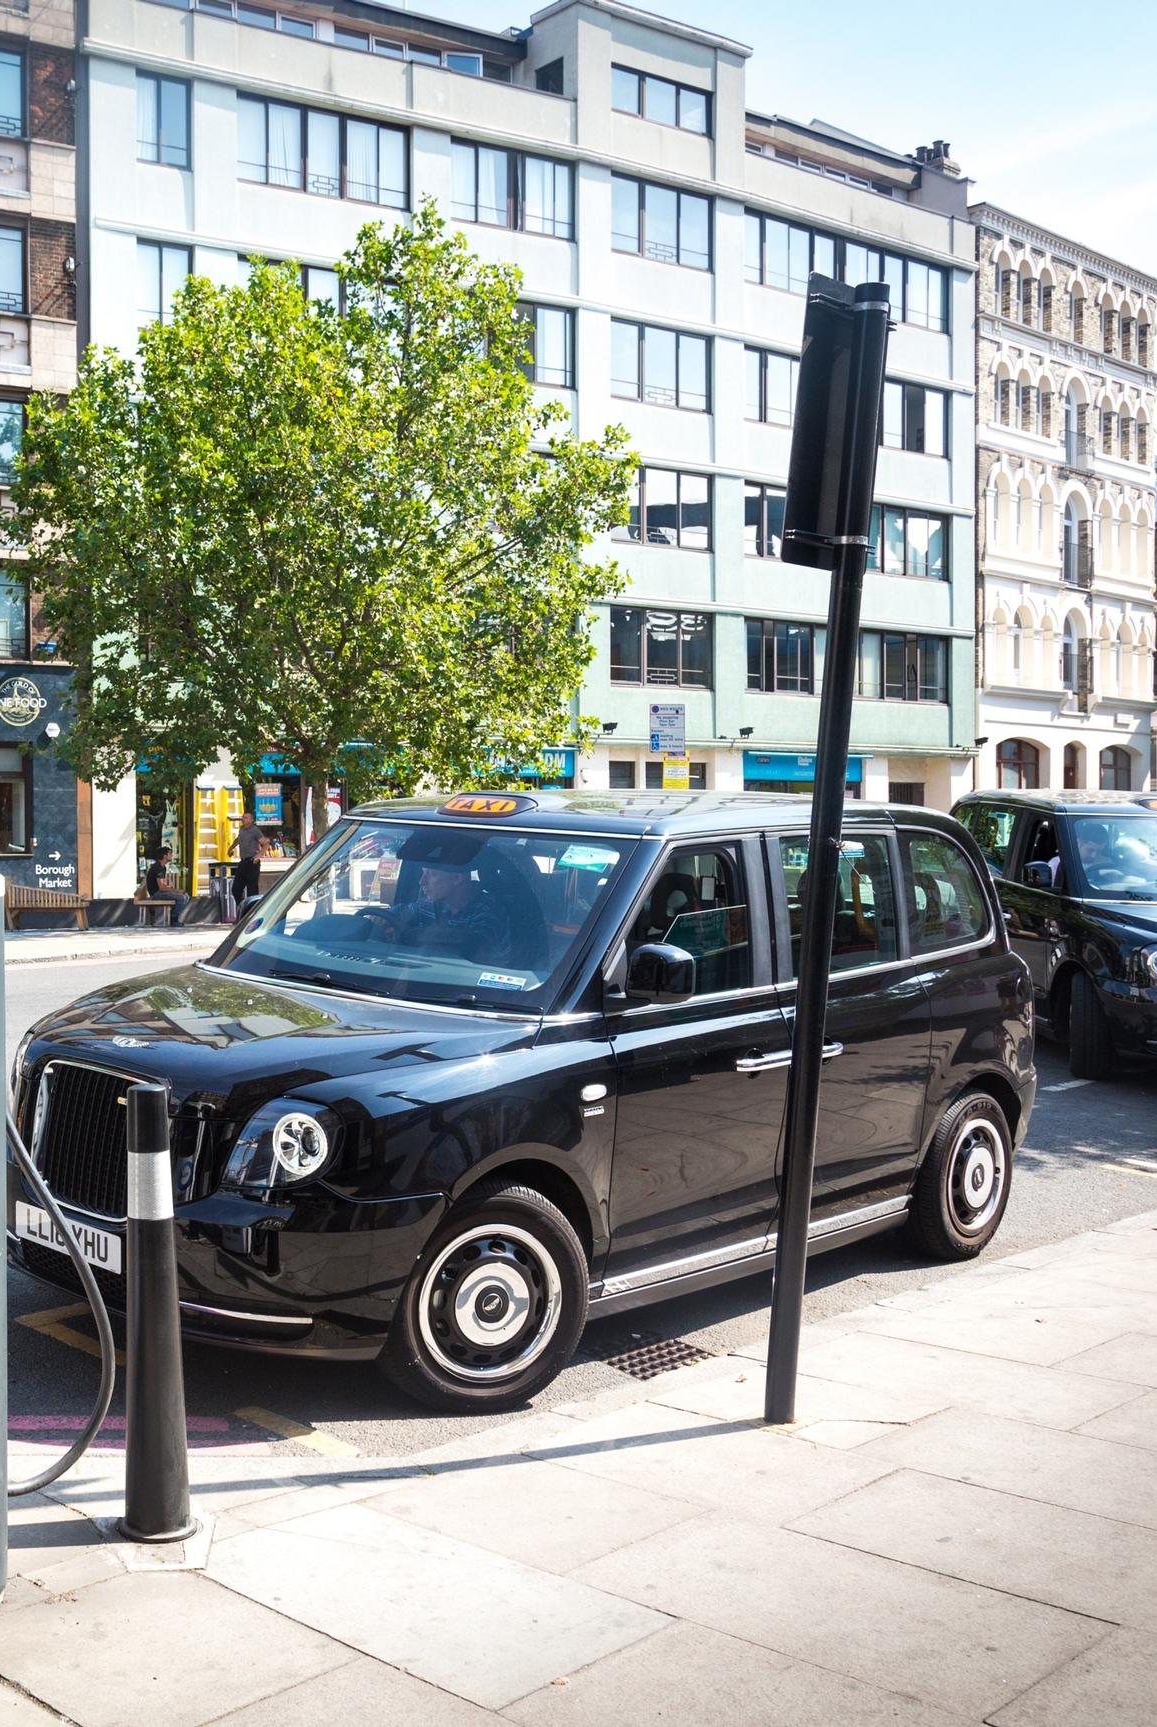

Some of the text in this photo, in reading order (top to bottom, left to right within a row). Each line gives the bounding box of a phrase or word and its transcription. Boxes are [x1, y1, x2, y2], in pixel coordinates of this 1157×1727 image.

[450, 798, 510, 811] TAXI
[35, 863, 75, 877] Borough
[38, 877, 73, 888] Market
